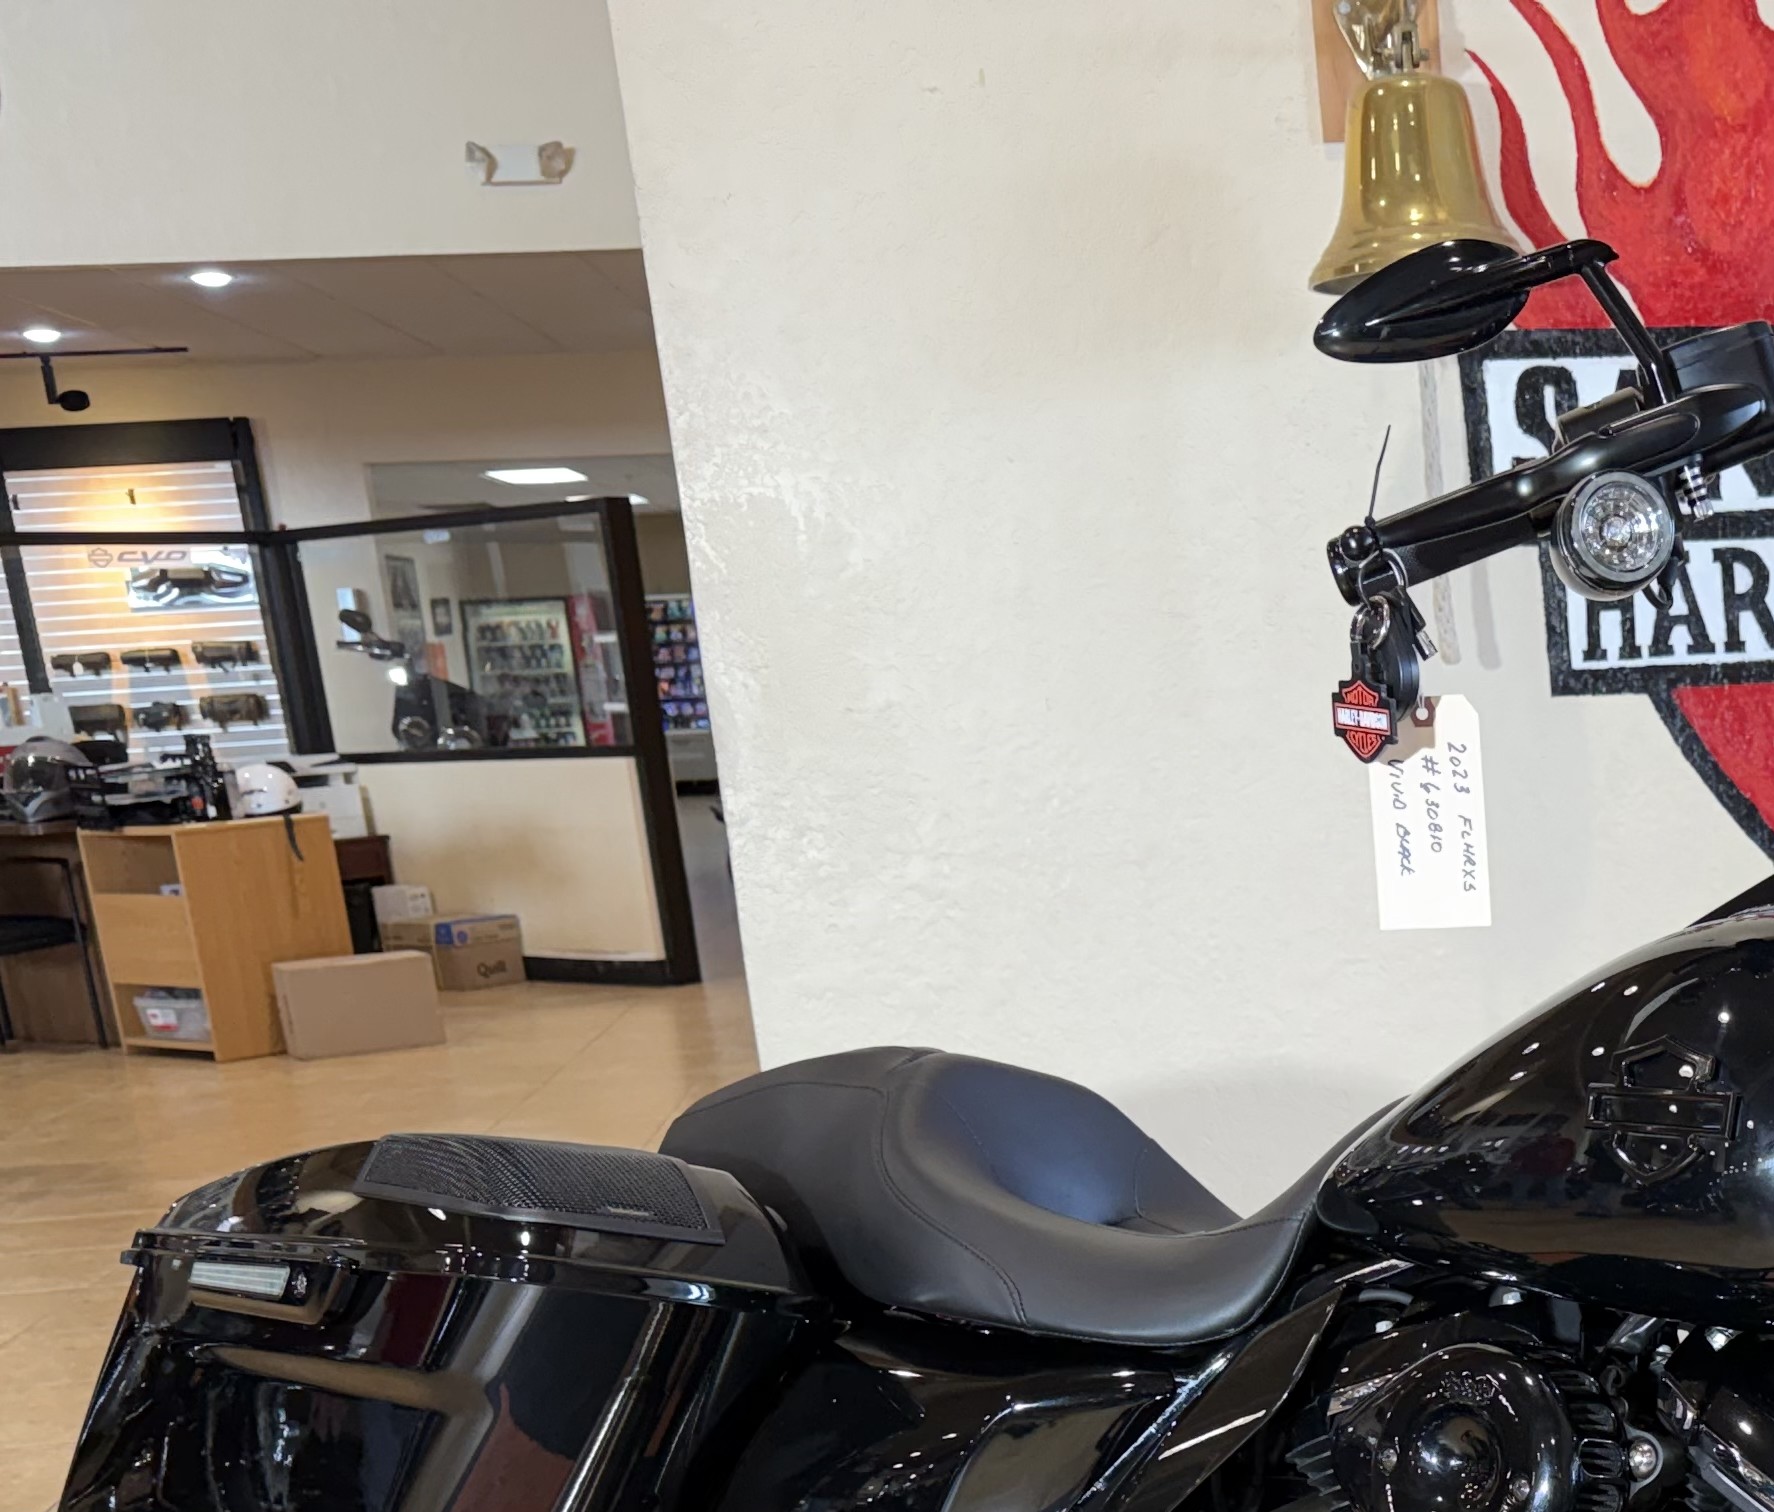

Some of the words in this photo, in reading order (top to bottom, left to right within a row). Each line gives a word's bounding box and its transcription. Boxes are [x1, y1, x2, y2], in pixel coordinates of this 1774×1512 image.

[117, 550, 187, 564] CVO
[1346, 686, 1376, 706] MOTOR
[1350, 730, 1379, 755] CYCLES
[1447, 741, 1471, 795] 2023
